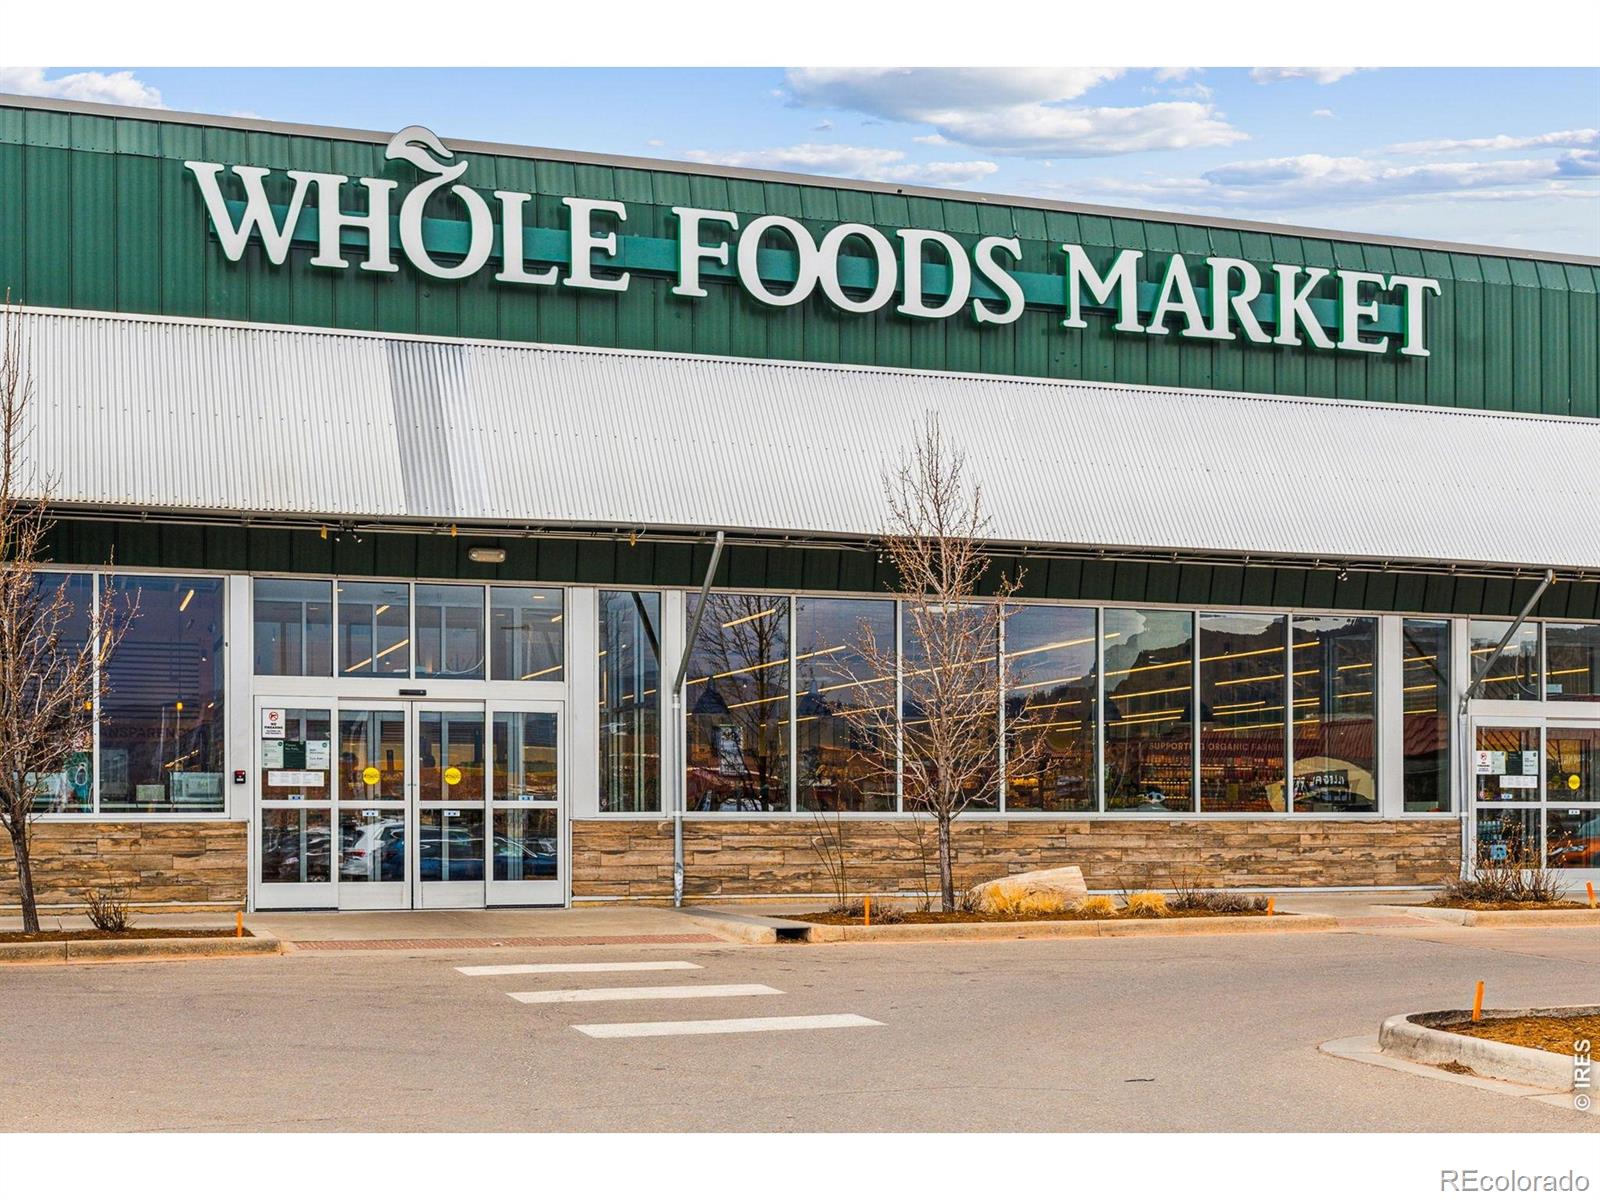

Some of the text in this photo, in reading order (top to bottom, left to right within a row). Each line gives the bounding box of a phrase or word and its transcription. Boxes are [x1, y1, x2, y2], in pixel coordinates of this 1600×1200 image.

[184, 125, 1442, 358] WHOLE FOODS MARKET
[1149, 742, 1206, 751] SUPPORTIG
